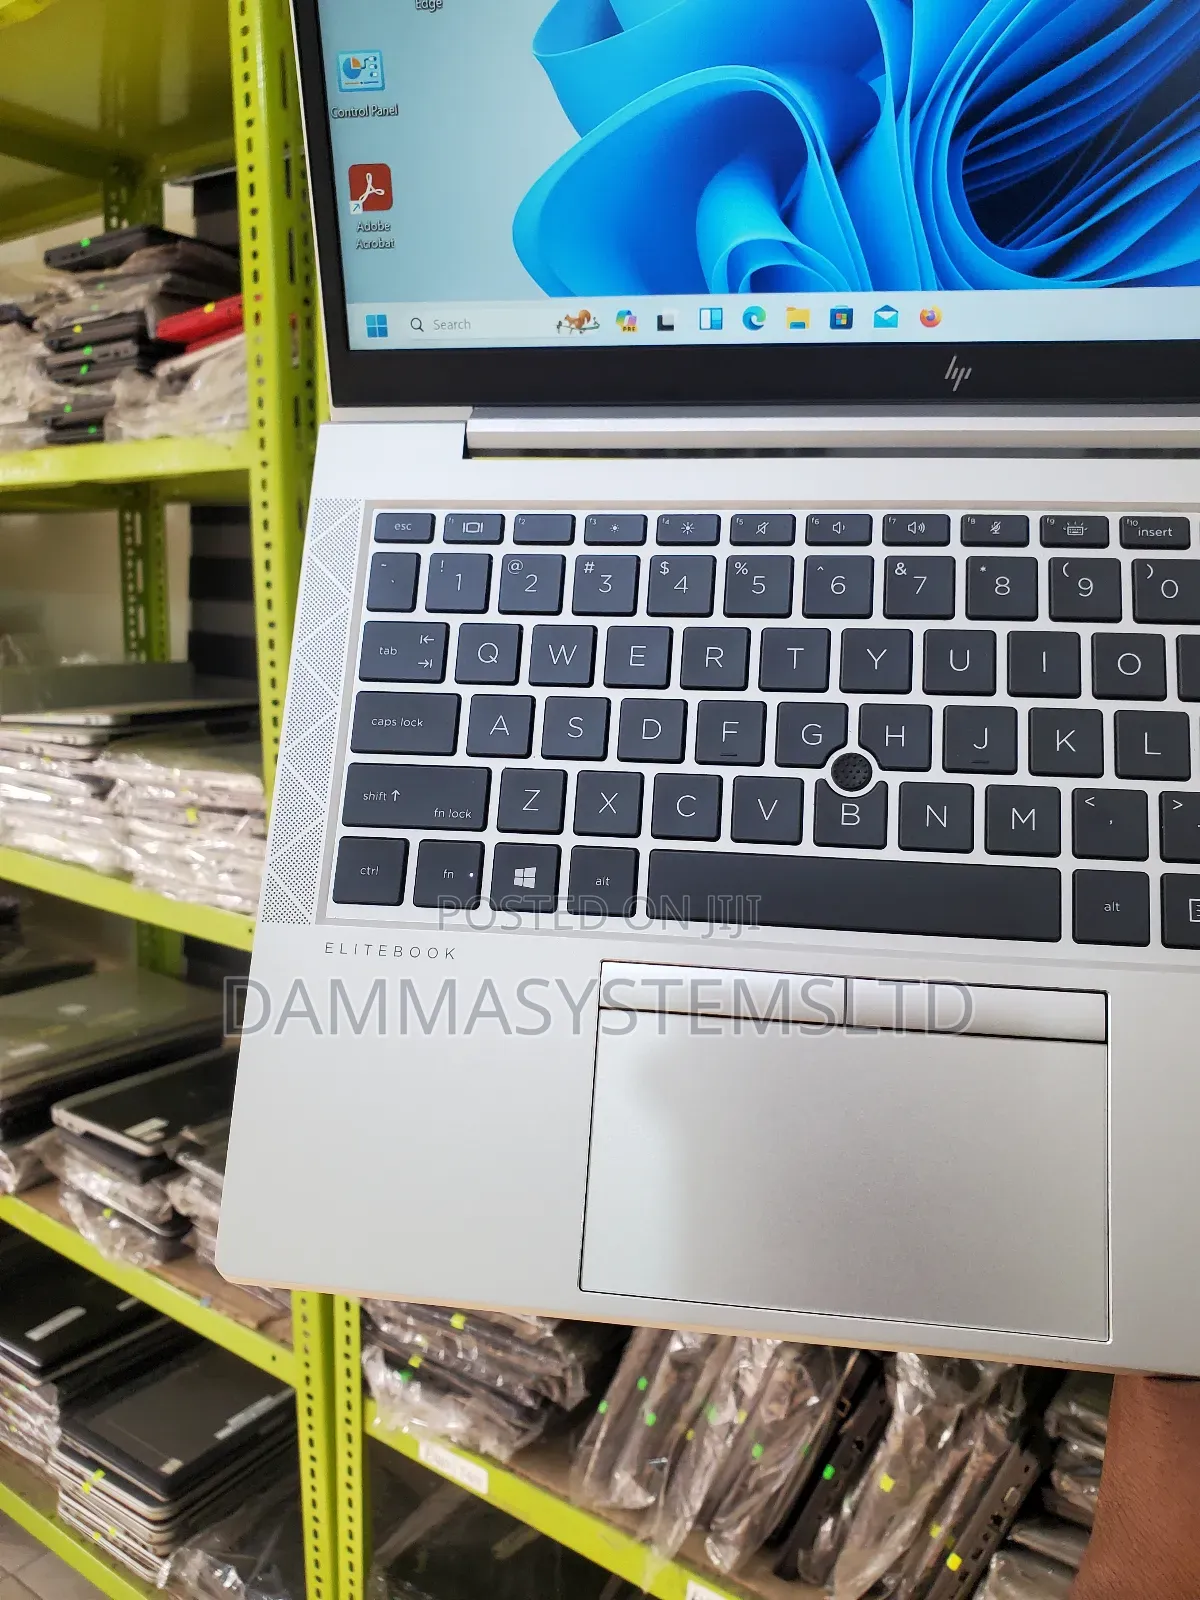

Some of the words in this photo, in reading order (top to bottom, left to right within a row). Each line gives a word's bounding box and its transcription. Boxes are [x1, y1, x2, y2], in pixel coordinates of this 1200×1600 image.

[415, 0, 443, 12] Edge
[331, 104, 370, 119] Control
[371, 104, 399, 117] Panel
[356, 220, 391, 233] Adobe
[355, 237, 395, 250] Acrobat
[433, 317, 471, 331] Search
[394, 523, 412, 531] esc
[811, 516, 820, 525] f6
[888, 516, 897, 525] f7
[1046, 517, 1055, 526] f9
[1138, 527, 1173, 537] insert
[507, 559, 524, 575] @
[583, 561, 596, 574] #
[659, 560, 670, 576] $
[734, 561, 749, 575] %
[894, 562, 907, 576] &
[455, 573, 462, 592] 1
[524, 573, 538, 593] 2
[598, 574, 612, 593] 3
[673, 575, 689, 594] 4
[751, 575, 766, 595] 5
[830, 575, 846, 595] 6
[913, 576, 927, 595] 7
[994, 576, 1011, 596] 8
[1077, 577, 1094, 597] 9
[1160, 579, 1179, 599] 0
[379, 646, 398, 656] tab
[477, 642, 499, 664] Q
[548, 644, 578, 666] W
[629, 645, 647, 667] E
[705, 646, 724, 668] R
[786, 647, 805, 670] T
[866, 648, 887, 670] Y
[949, 649, 970, 672] U
[1042, 651, 1047, 673] I
[1117, 652, 1142, 676] O
[371, 718, 397, 727] caps
[400, 717, 424, 727] lock
[489, 714, 510, 736] A
[567, 716, 584, 738] S
[641, 718, 662, 740] D
[722, 721, 740, 743] F
[801, 723, 823, 746] G
[885, 725, 905, 747] H
[973, 727, 988, 750] J
[1056, 729, 1076, 752] K
[1144, 731, 1162, 755] L
[362, 791, 387, 801] shift
[522, 789, 541, 811] Z
[598, 792, 619, 814] X
[676, 794, 697, 818] C
[434, 807, 445, 818] fn
[448, 808, 472, 819] lock
[757, 798, 778, 821] V
[841, 802, 861, 826] B
[926, 804, 947, 828] N
[1011, 807, 1036, 831] M
[360, 865, 379, 876] ctrl
[443, 868, 454, 879] fn
[595, 876, 611, 886] alt
[1103, 901, 1121, 912] alt
[324, 942, 457, 962] ELITEBOOK
